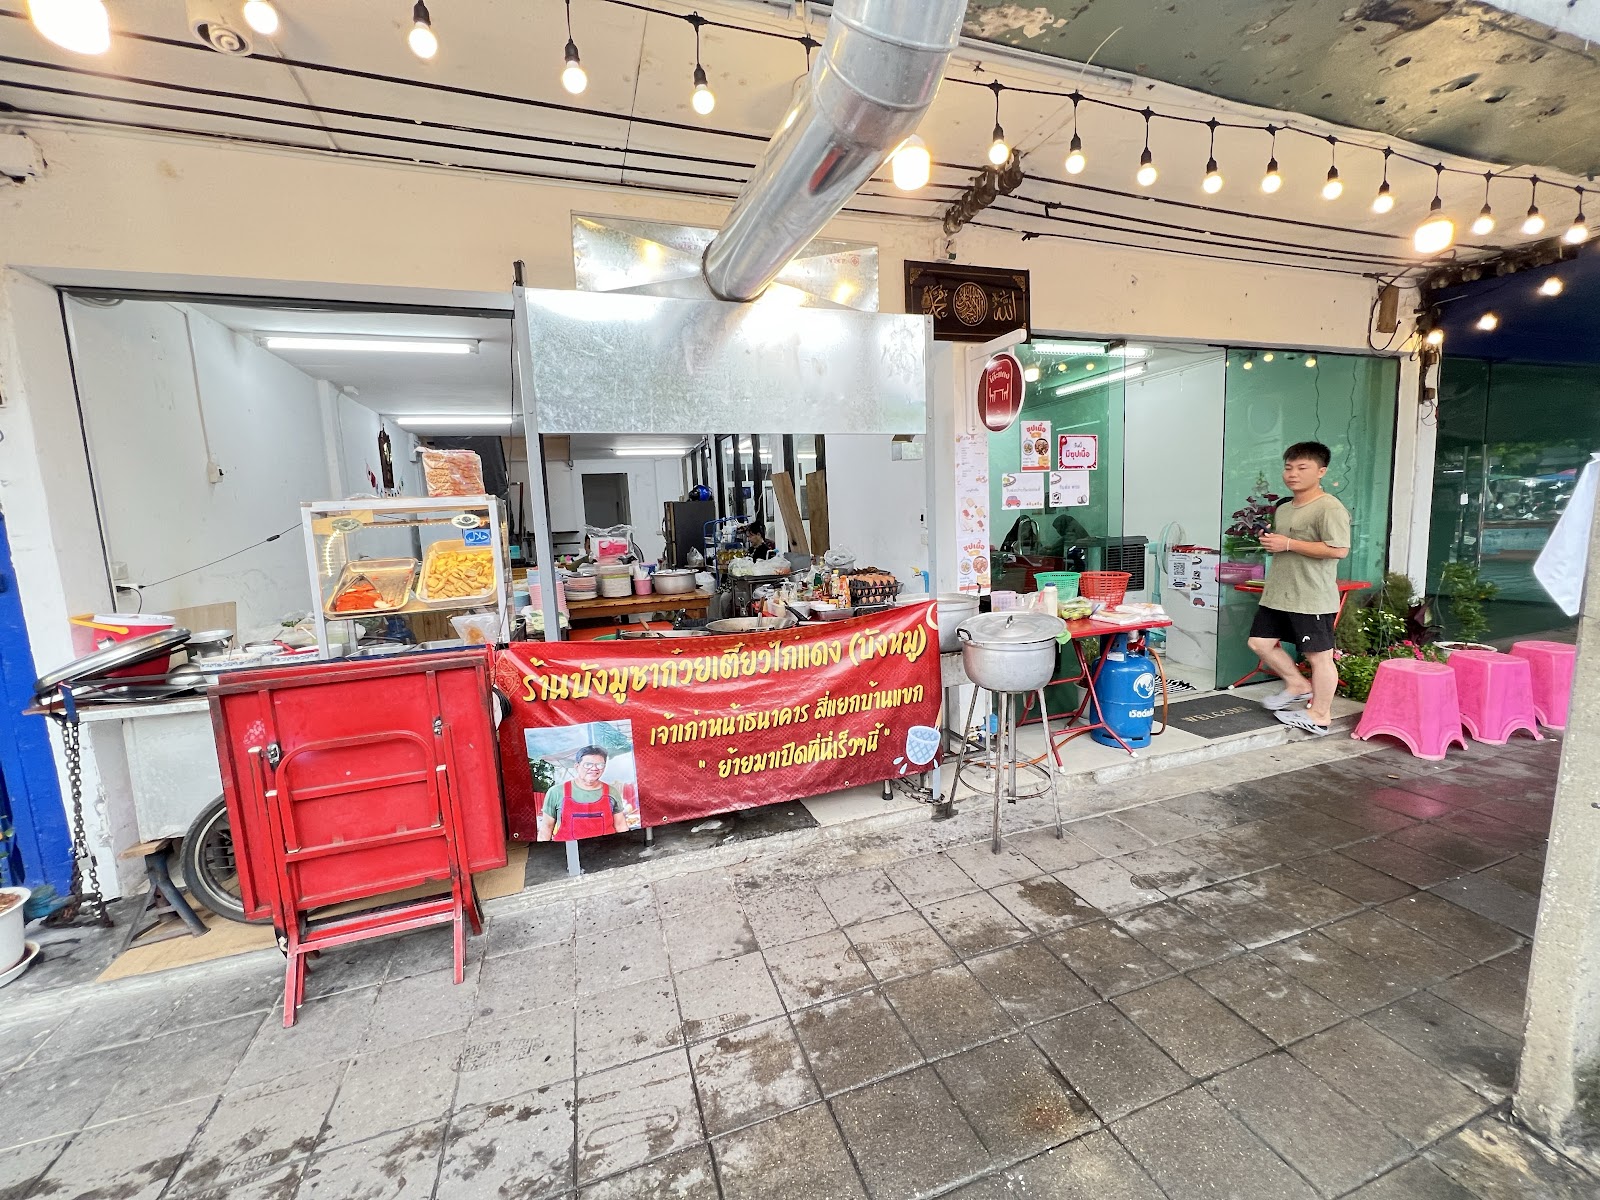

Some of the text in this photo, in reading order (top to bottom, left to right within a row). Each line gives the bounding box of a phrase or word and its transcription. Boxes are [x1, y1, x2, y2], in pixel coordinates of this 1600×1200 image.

[1065, 447, 1091, 460] มีซุปเนื้อ
[522, 623, 928, 704] ร้านบังมูซาก๋วยเตี๋ยวไก่แดง (บังหมู)
[650, 680, 924, 746] เจ้าเก่าหน้าธนาคาร สี่แยกบ้านแขก
[1181, 706, 1252, 723] WELCOME
